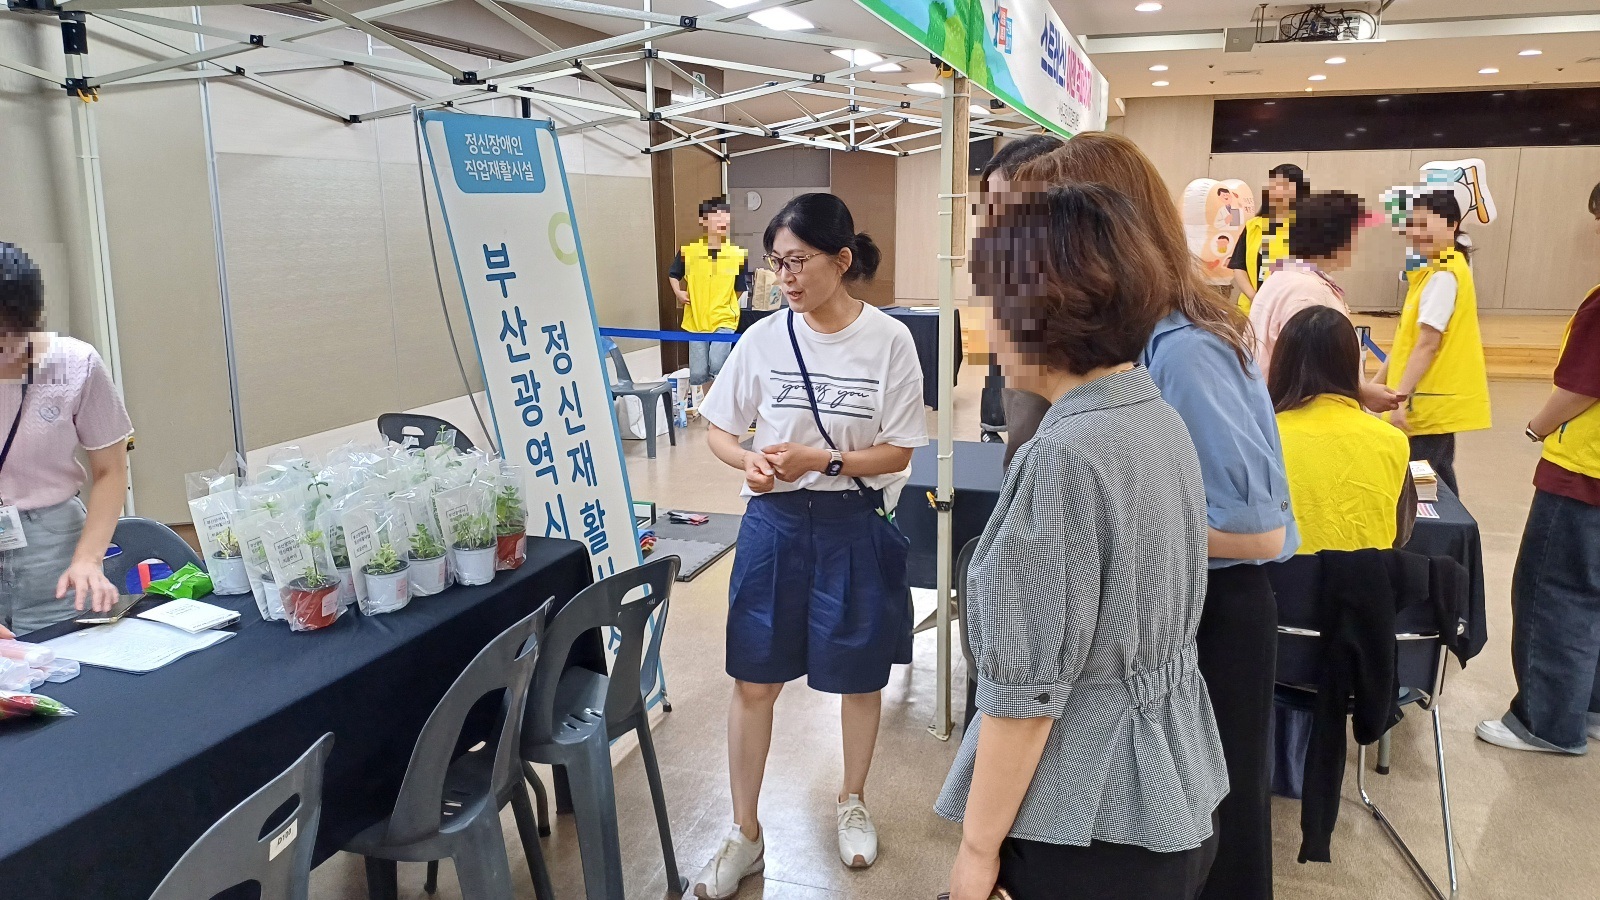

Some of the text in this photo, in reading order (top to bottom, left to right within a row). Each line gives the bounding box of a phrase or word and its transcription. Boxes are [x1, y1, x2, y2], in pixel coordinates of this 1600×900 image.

[464, 132, 524, 155] 정신장애인
[464, 159, 535, 182] 직업재활시설
[482, 242, 571, 540] 부산광역시
[829, 389, 870, 409] you
